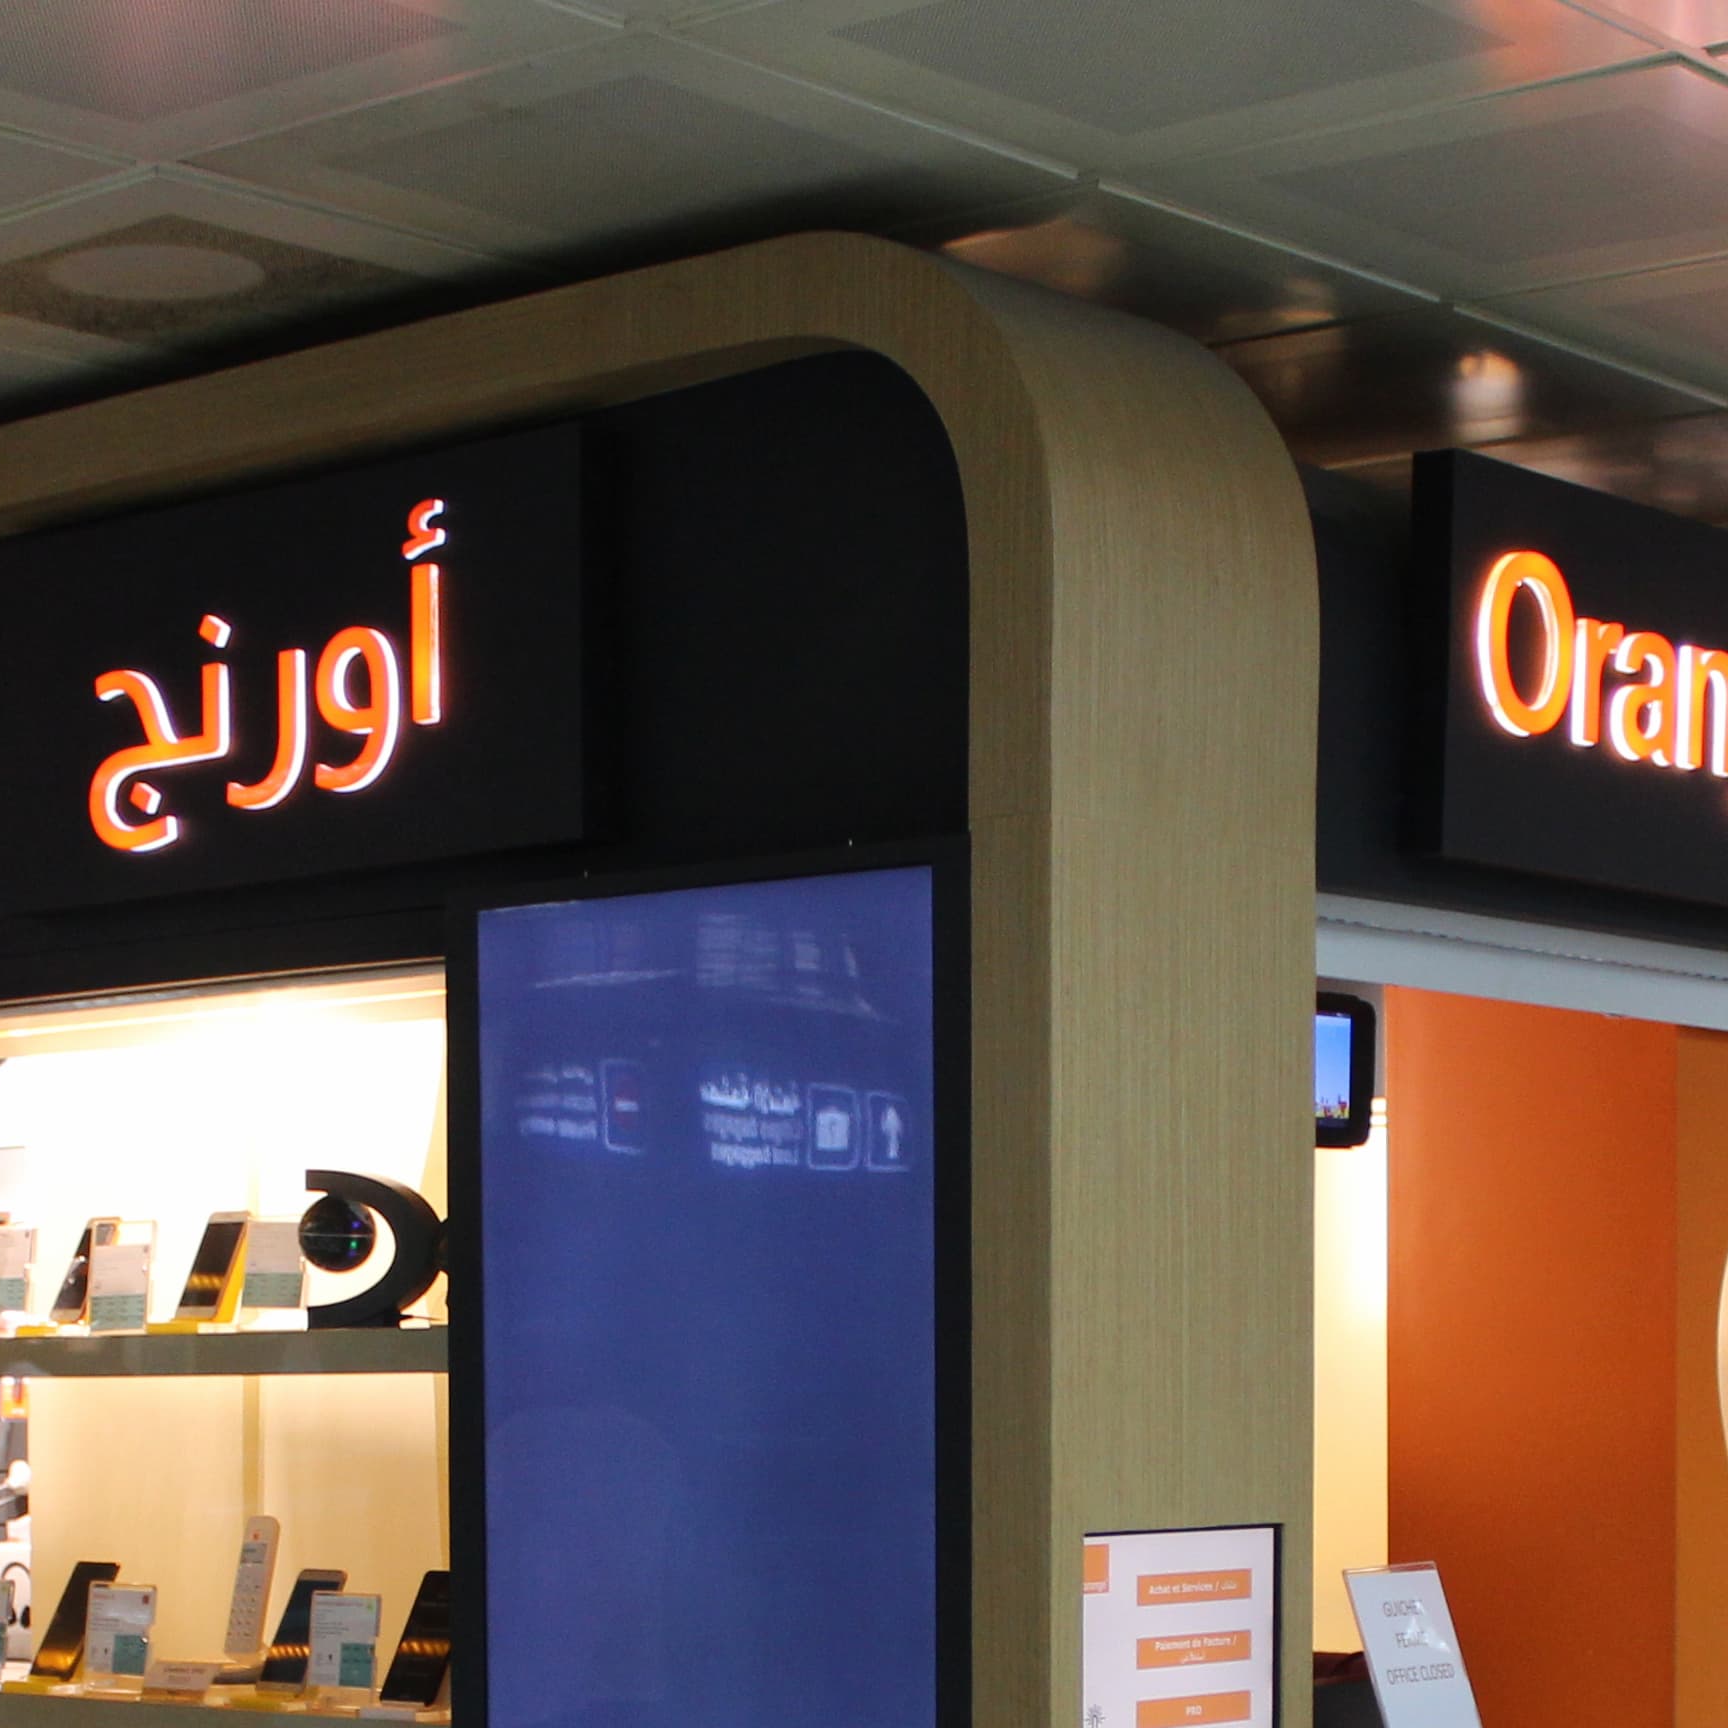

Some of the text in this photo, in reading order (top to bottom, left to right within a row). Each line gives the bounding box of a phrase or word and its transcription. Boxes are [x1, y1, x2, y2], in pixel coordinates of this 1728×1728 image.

[89, 498, 448, 853] أورنج
[1386, 1662, 1456, 1685] OFFICE CLOSED
